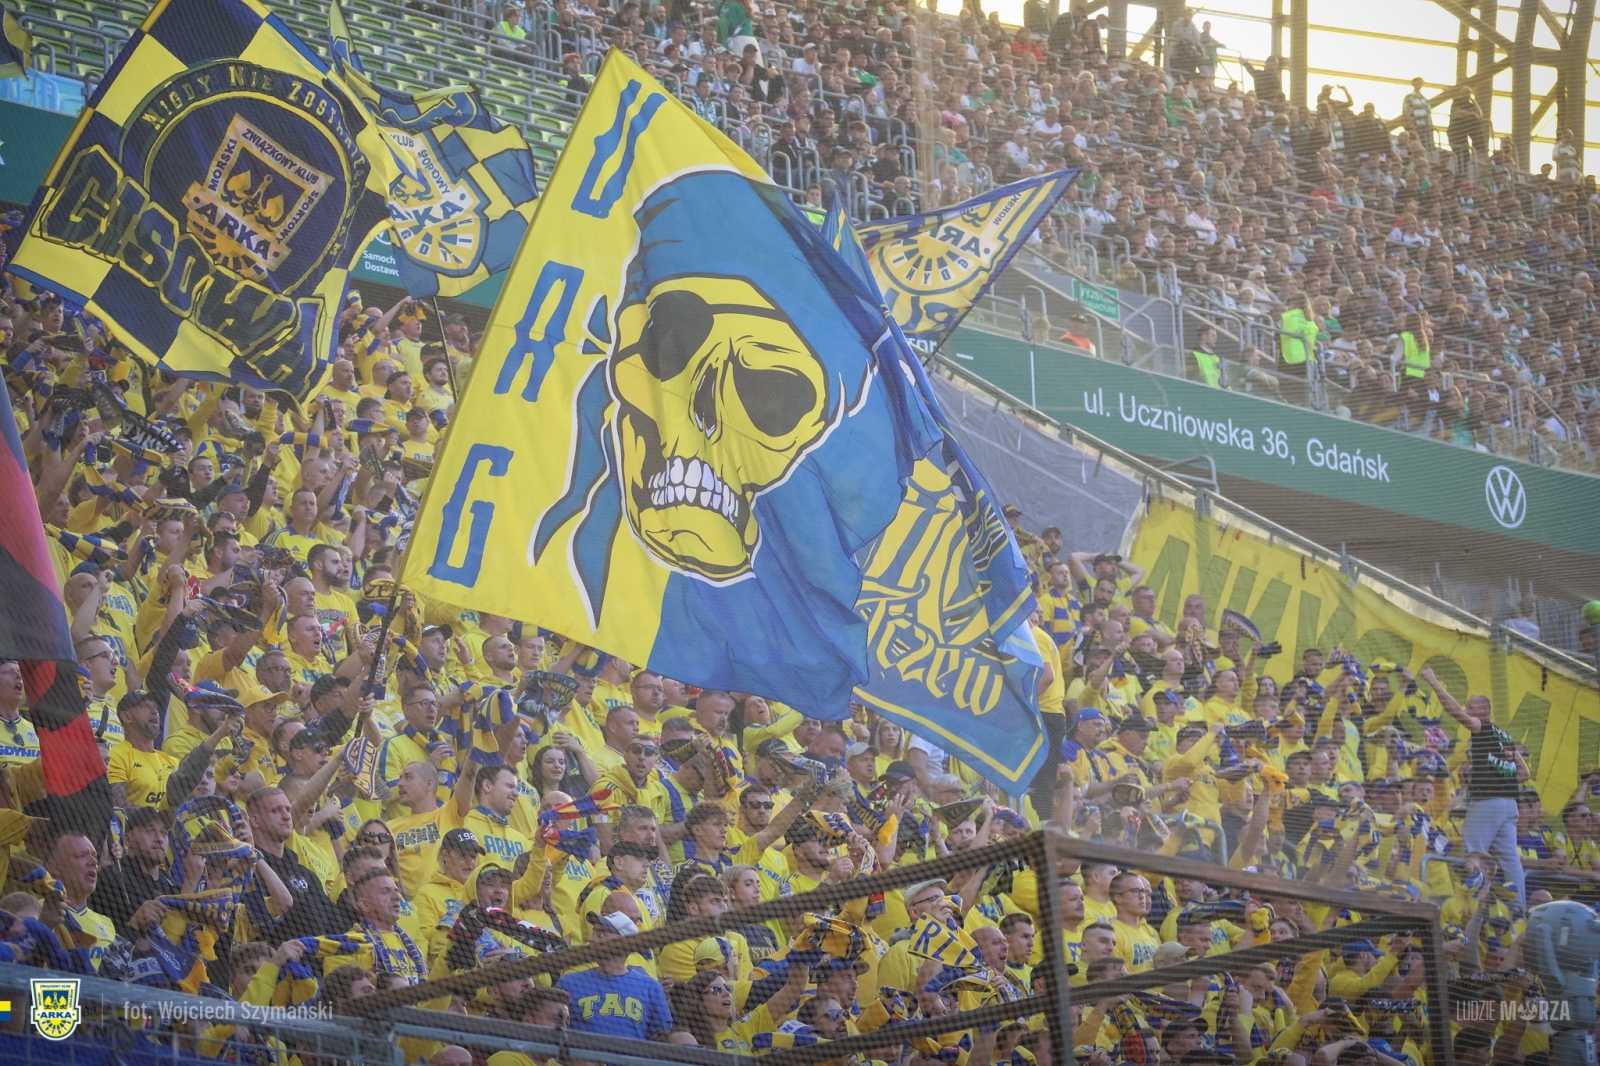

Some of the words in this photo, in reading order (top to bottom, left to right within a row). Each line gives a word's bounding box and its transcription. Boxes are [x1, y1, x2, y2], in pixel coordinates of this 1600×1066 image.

[142, 75, 211, 131] NIGDY
[228, 65, 272, 91] NIE
[207, 138, 238, 192] MORSKI
[241, 128, 297, 171] ZWIĄZKOWY
[295, 163, 320, 185] KLUB
[417, 149, 451, 195] SPORTOWY
[195, 202, 271, 261] ARKA
[274, 190, 319, 245] SPORTOWY
[363, 250, 396, 264] Samoch
[1084, 388, 1110, 417] ul.
[1119, 391, 1255, 451] Uczniowska
[1261, 426, 1296, 465] 36,
[1306, 437, 1391, 483] Gdańsk
[578, 993, 643, 1023] TAG
